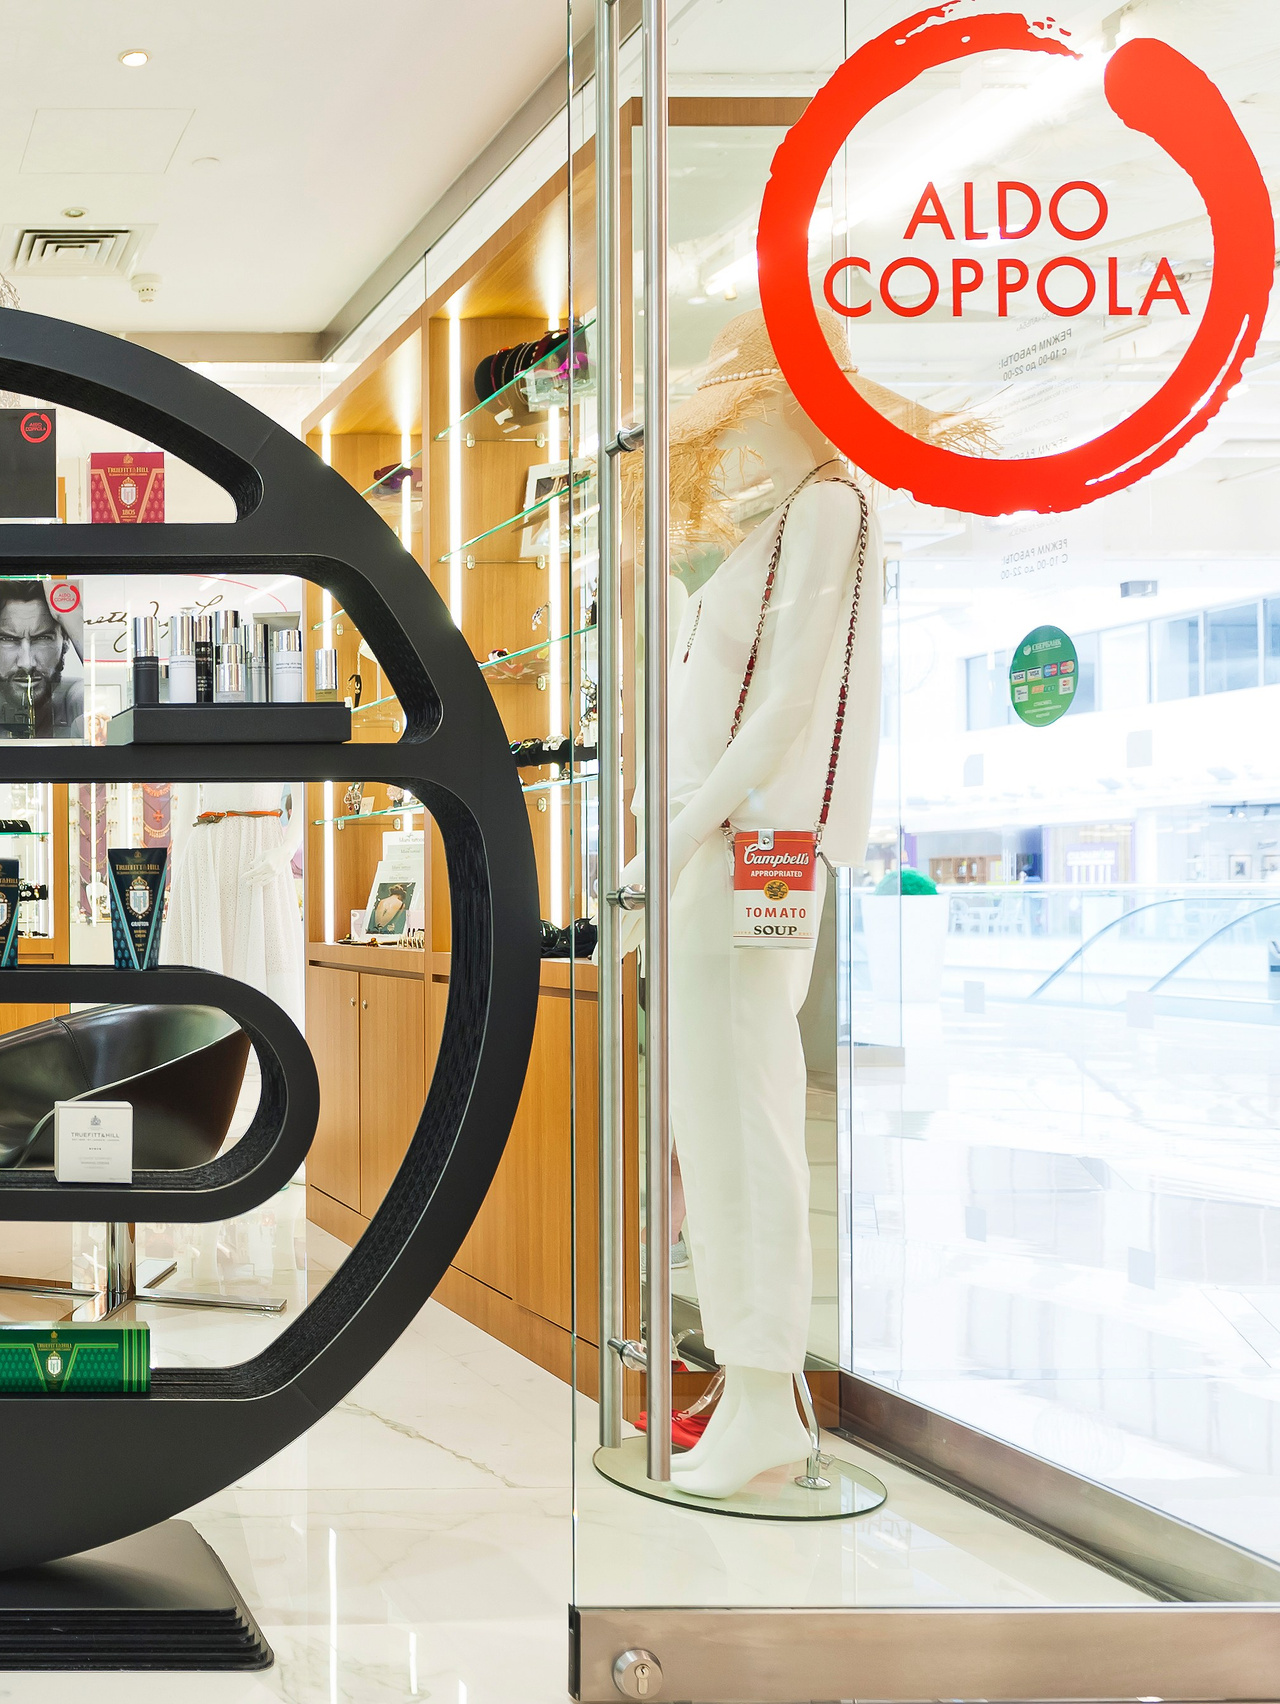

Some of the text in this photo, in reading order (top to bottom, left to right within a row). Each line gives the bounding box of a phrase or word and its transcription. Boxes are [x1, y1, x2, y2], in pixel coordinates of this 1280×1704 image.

[903, 180, 1108, 241] ALDO
[823, 256, 1191, 317] COPPOLA
[743, 843, 810, 868] Campbell's
[750, 870, 803, 878] APPROPRIATED
[745, 907, 806, 918] TOMATO
[753, 925, 798, 936] SOUP
